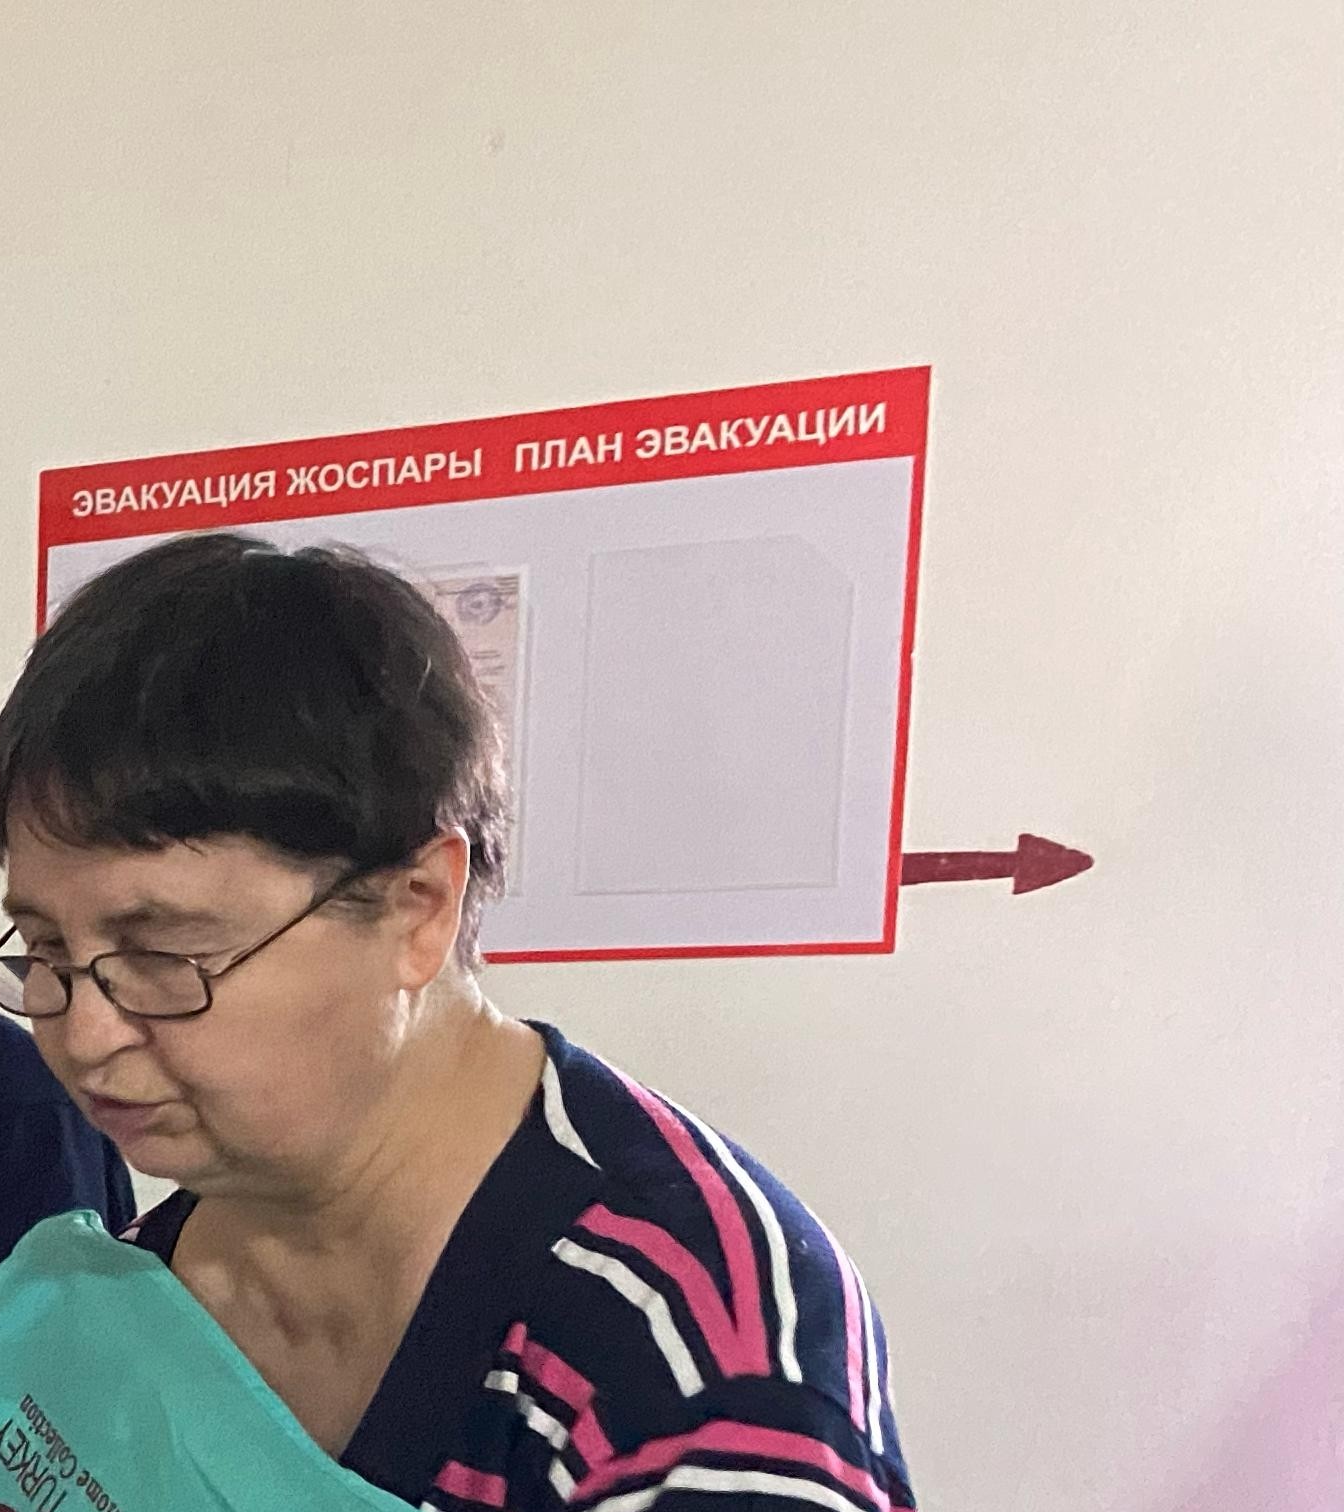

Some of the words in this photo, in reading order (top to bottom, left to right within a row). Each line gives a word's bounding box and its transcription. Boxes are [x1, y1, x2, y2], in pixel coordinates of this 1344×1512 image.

[72, 469, 276, 518] ЭВАКУАЦИЯ
[286, 448, 483, 496] ЖОСПАРЫ
[515, 431, 623, 473] ПЛАН
[634, 402, 887, 460] ЭВАКУАЦИИ
[20, 1393, 78, 1481] Collection
